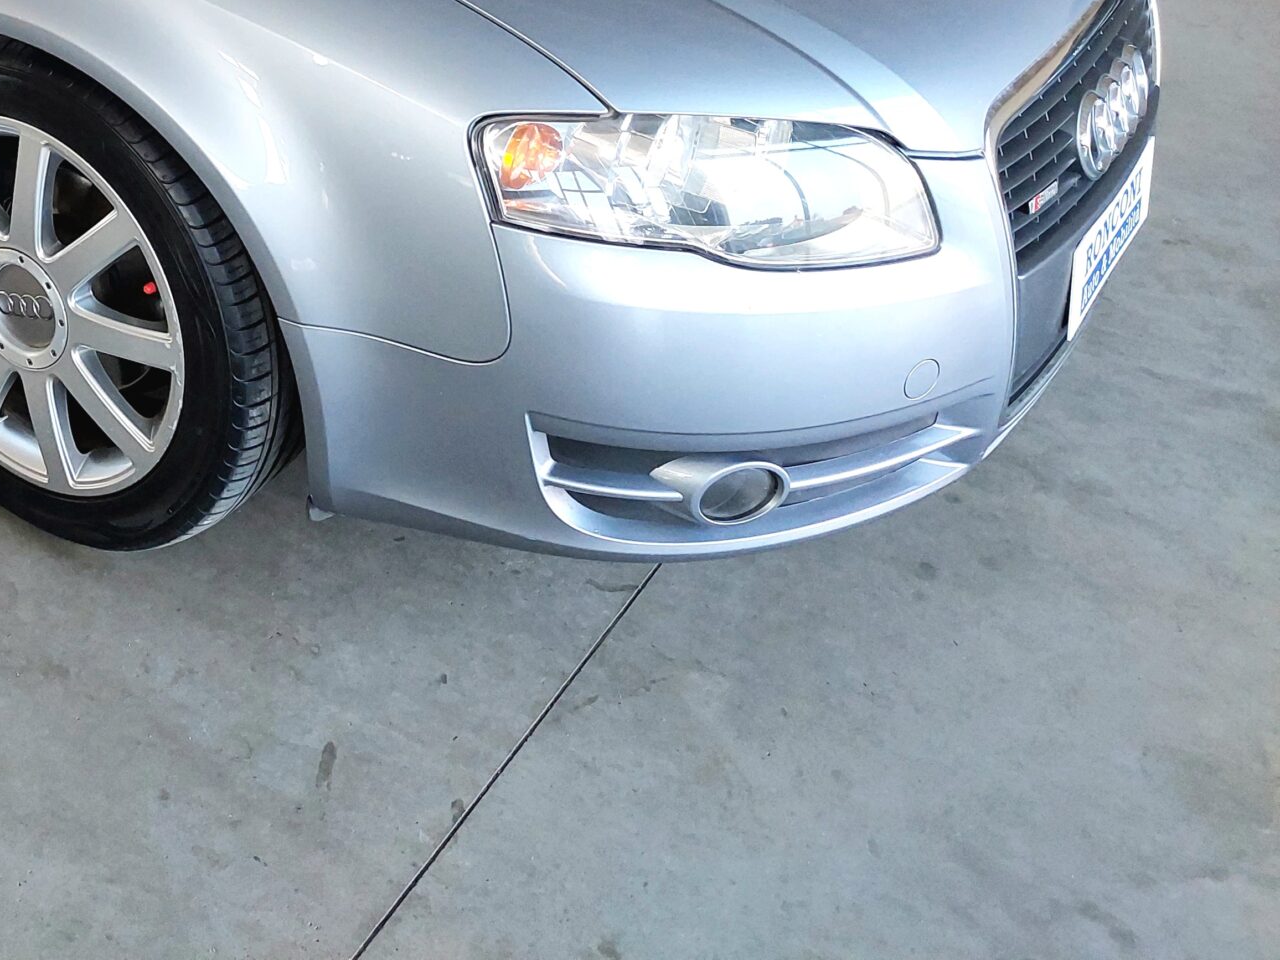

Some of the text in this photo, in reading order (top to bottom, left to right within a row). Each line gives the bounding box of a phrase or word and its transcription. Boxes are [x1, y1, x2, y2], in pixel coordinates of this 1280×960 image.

[1085, 167, 1143, 275] RONCONI
[1081, 274, 1101, 310] Auto
[1100, 255, 1108, 273] &
